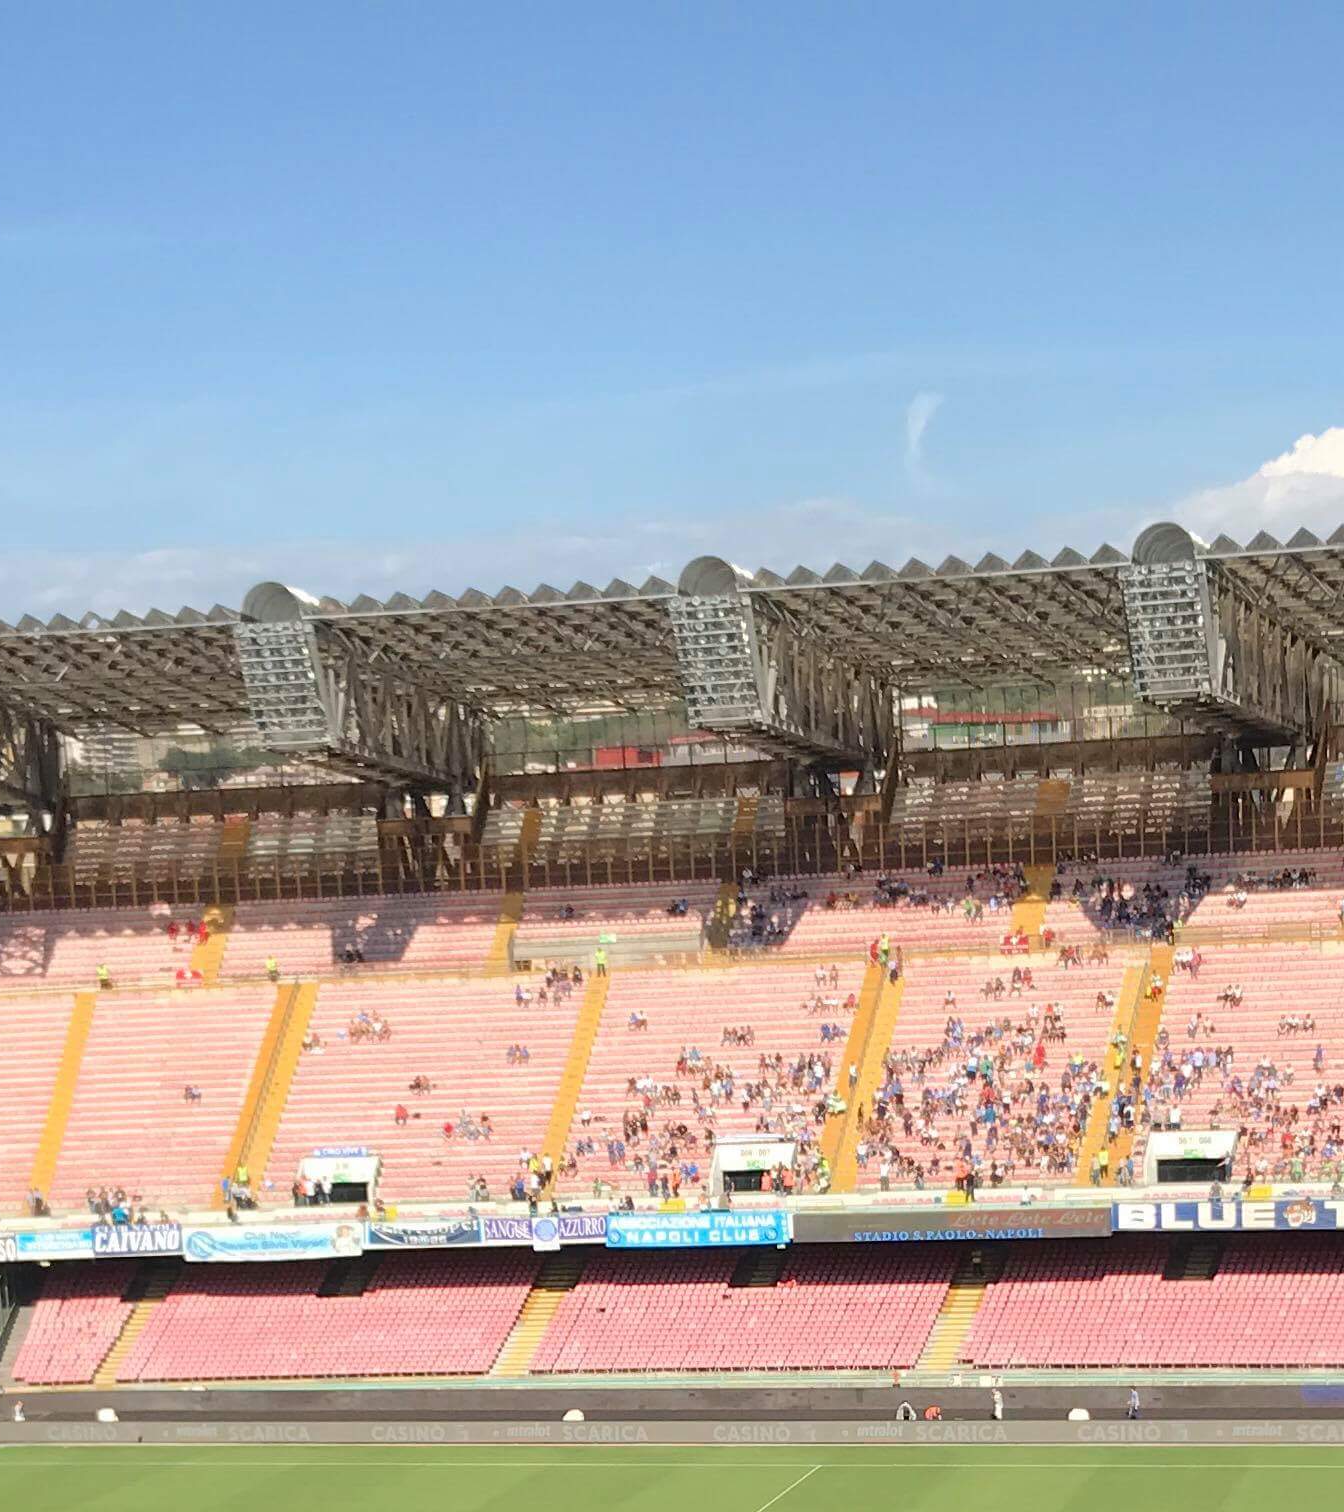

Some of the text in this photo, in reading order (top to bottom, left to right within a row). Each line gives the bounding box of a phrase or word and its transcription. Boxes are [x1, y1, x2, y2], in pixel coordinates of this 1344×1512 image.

[714, 1214, 775, 1227] ITALIANA
[1118, 1202, 1275, 1230] BLUE
[559, 1216, 606, 1238] AZZURRO
[95, 1230, 181, 1252] CAIVANO
[854, 1231, 909, 1241] STADIO
[562, 1425, 649, 1441] SCARICA
[916, 1424, 1008, 1441] SCARICA
